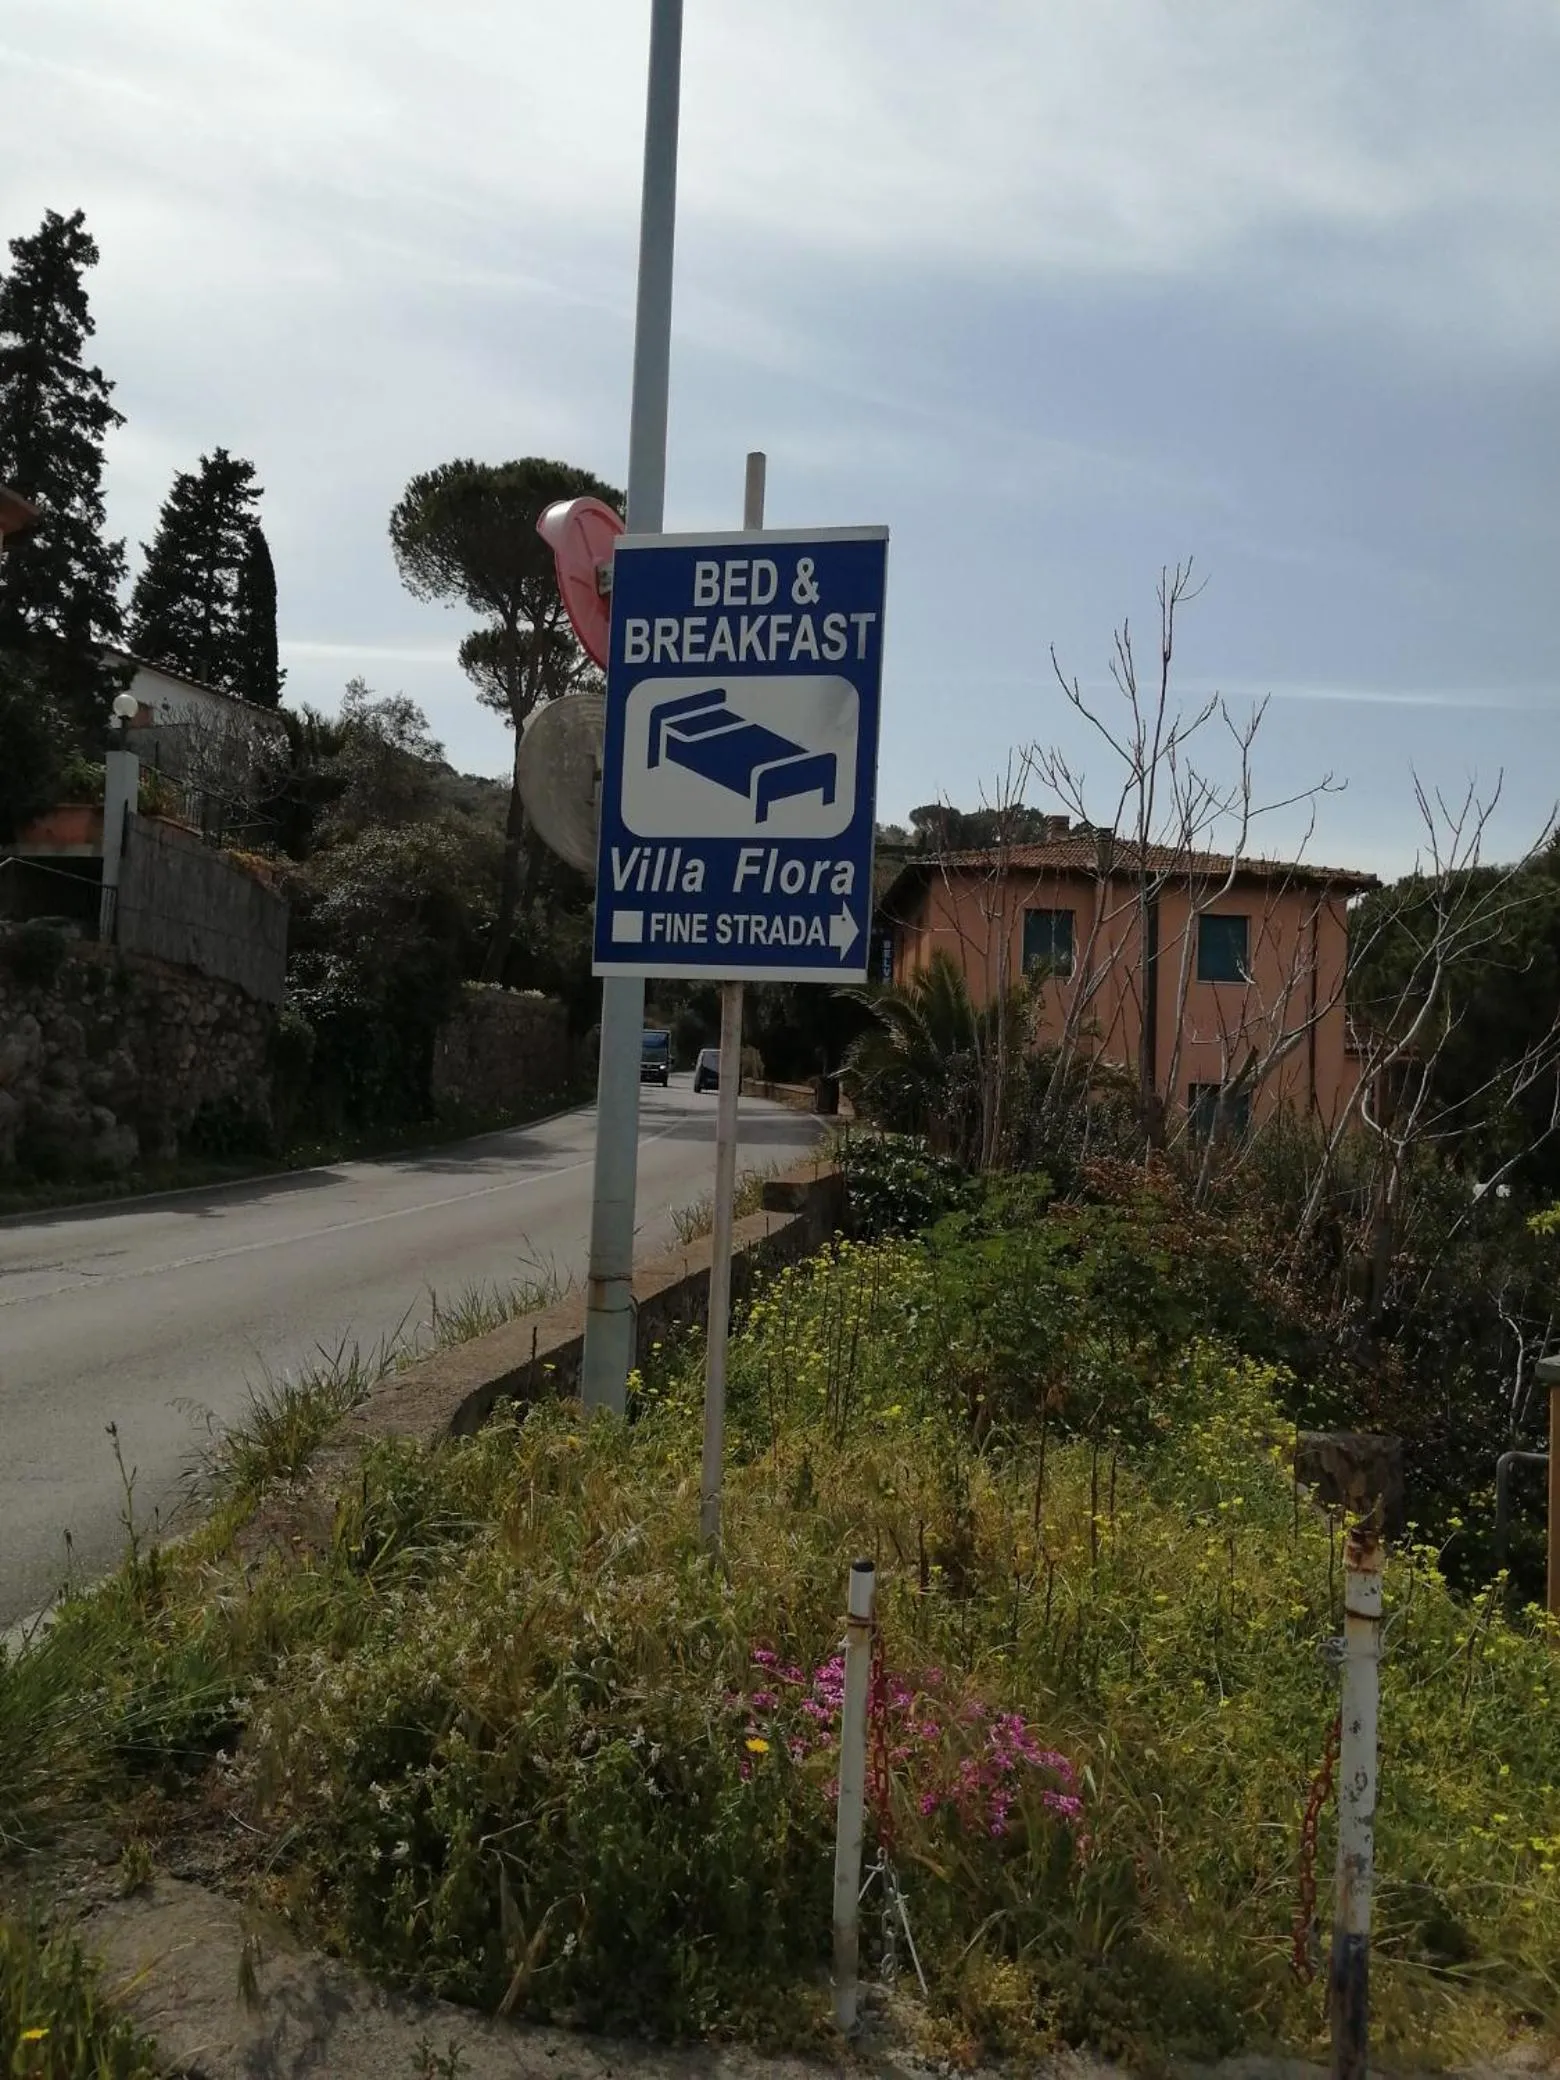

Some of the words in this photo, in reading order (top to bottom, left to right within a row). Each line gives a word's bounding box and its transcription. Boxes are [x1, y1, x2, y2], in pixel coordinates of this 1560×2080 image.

[694, 559, 778, 606] BED
[792, 557, 820, 605] &
[624, 612, 876, 664] BREAKFAST
[611, 846, 706, 893] Villa
[733, 847, 856, 895] Flora
[650, 912, 708, 945] FINE
[716, 912, 826, 947] STRADA
